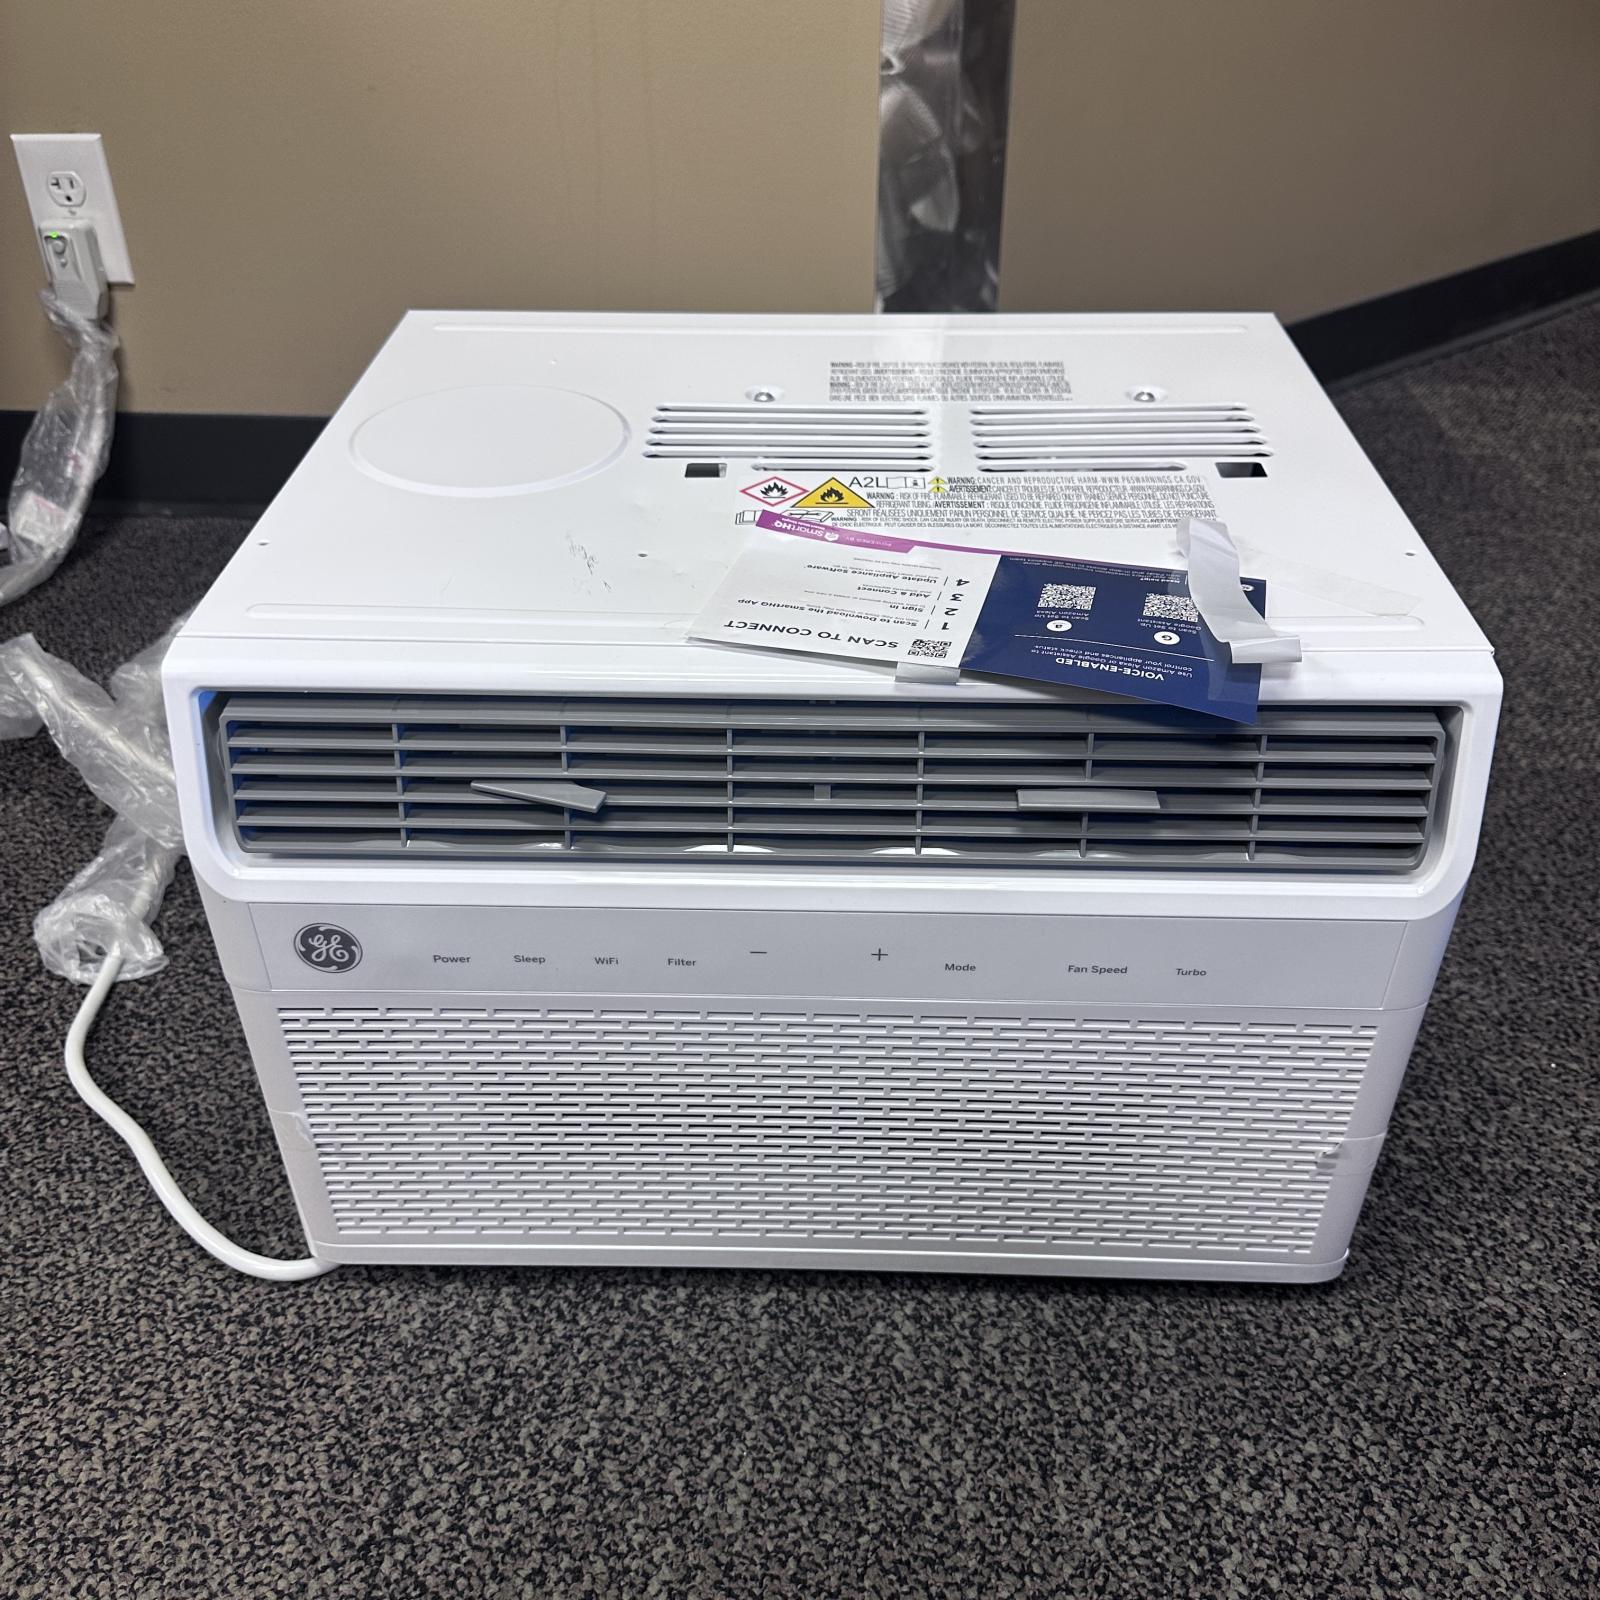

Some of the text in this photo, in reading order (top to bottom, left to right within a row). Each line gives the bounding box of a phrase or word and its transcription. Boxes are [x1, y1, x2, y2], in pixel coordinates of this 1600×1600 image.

[849, 476, 888, 488] A2L
[851, 570, 898, 581] Appliance
[902, 575, 937, 584] Update
[956, 579, 970, 587] 4
[857, 586, 898, 595] Connect
[950, 593, 964, 601] 3
[901, 605, 925, 613] Sign
[944, 608, 958, 616] 2
[826, 610, 877, 622] Download
[941, 622, 950, 630] 1
[723, 620, 899, 648] SCAN TO CONNECT
[1059, 647, 1082, 655] check
[1078, 654, 1107, 663] Google
[1101, 653, 1142, 664] appliances
[1055, 657, 1165, 681] VOICE-ENABLED
[1118, 661, 1140, 670] Alexa
[1164, 663, 1193, 671] control
[1142, 665, 1176, 676] Amazon
[1177, 670, 1193, 678] Use
[433, 954, 977, 972] Power Sleep WiFi Filter Mode
[1067, 964, 1128, 976] Fan Speed
[1175, 968, 1207, 977] Turbo
